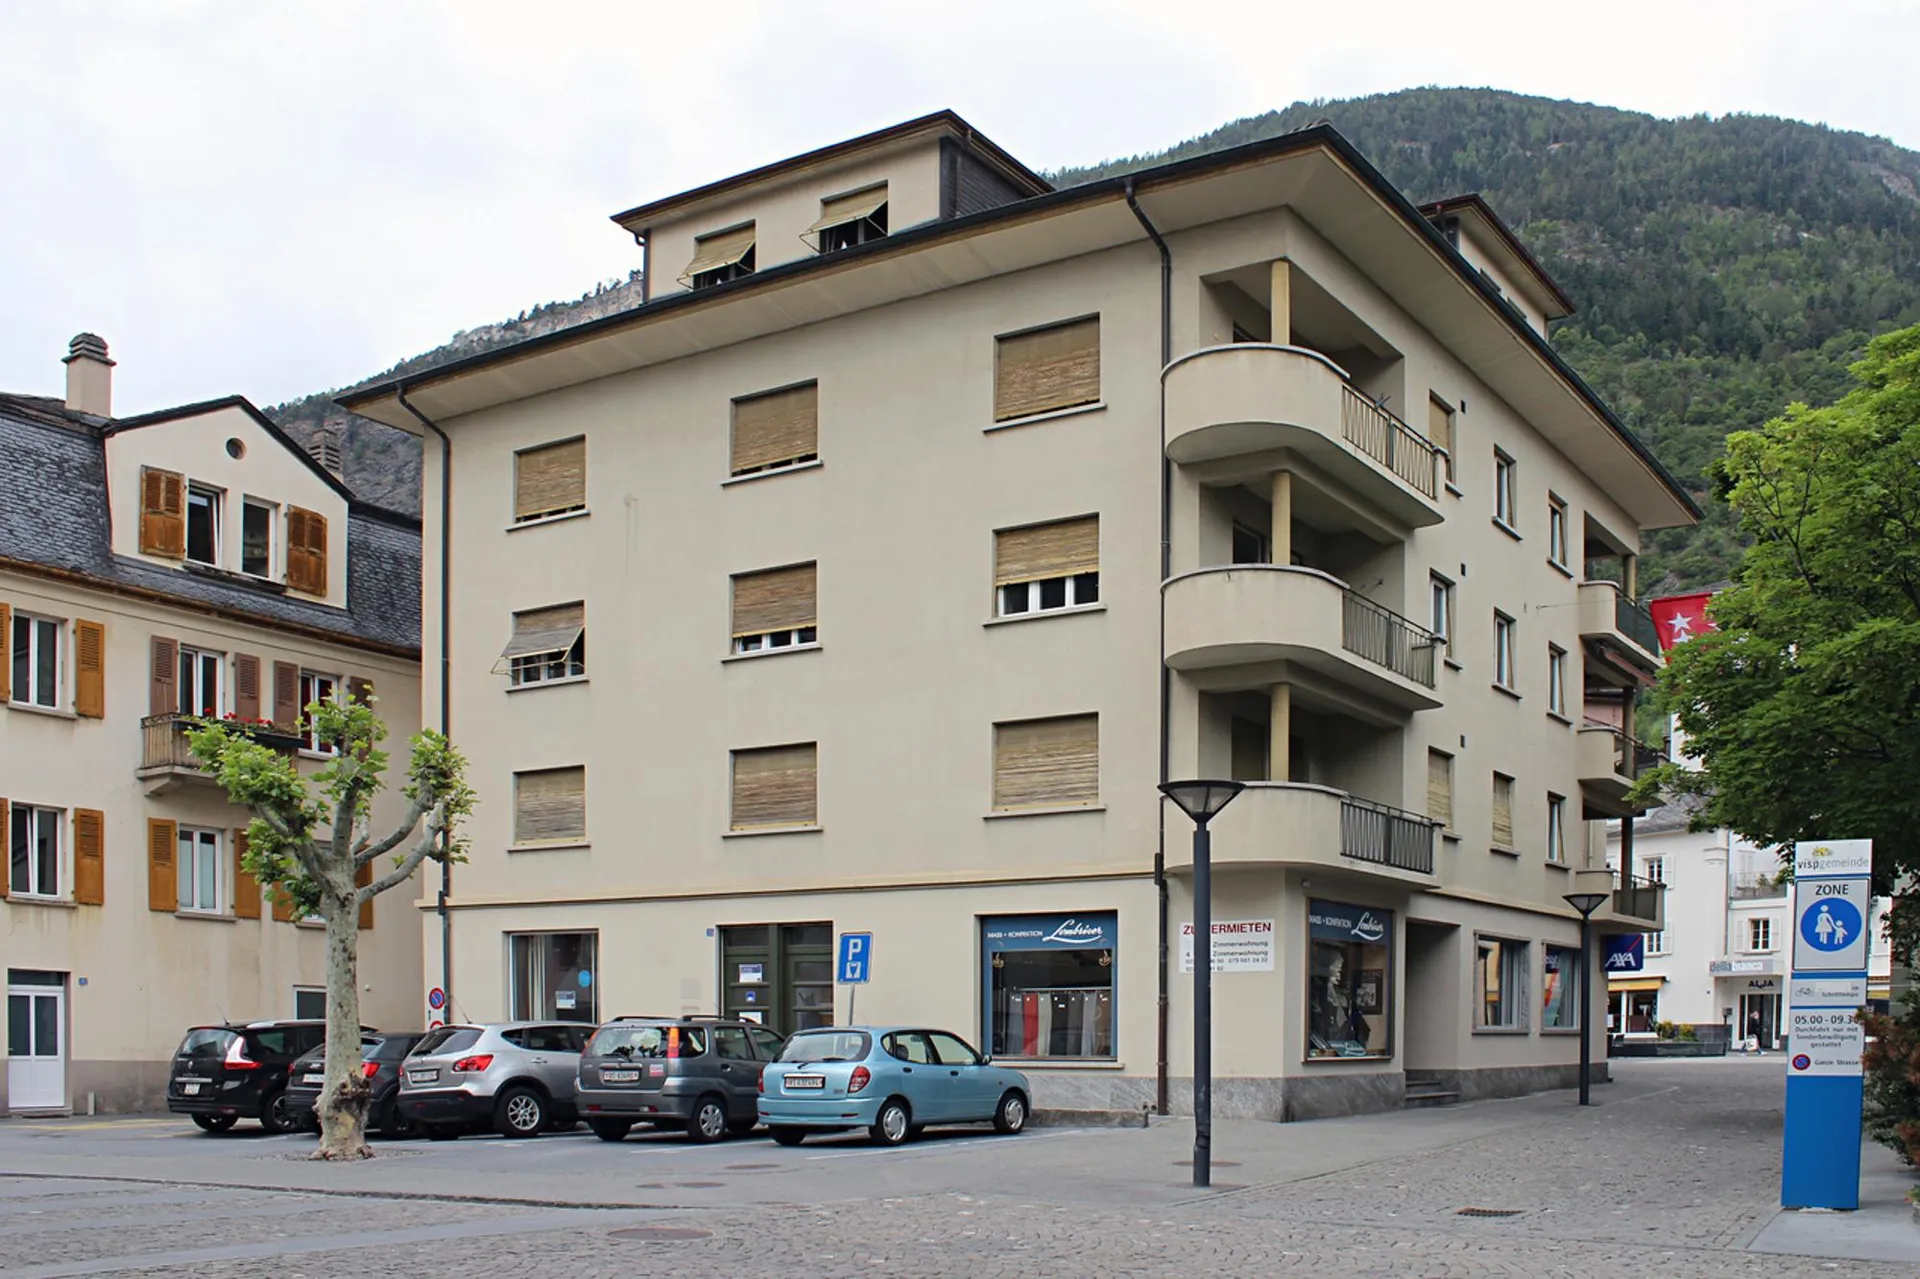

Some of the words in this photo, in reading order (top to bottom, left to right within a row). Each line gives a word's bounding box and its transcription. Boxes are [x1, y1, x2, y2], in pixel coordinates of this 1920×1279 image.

[1815, 884, 1849, 896] ZONE
[1211, 922, 1272, 934] ERMIETEN
[848, 938, 862, 961] P
[1604, 952, 1636, 968] AXA
[1795, 1015, 1823, 1025] 05.00
